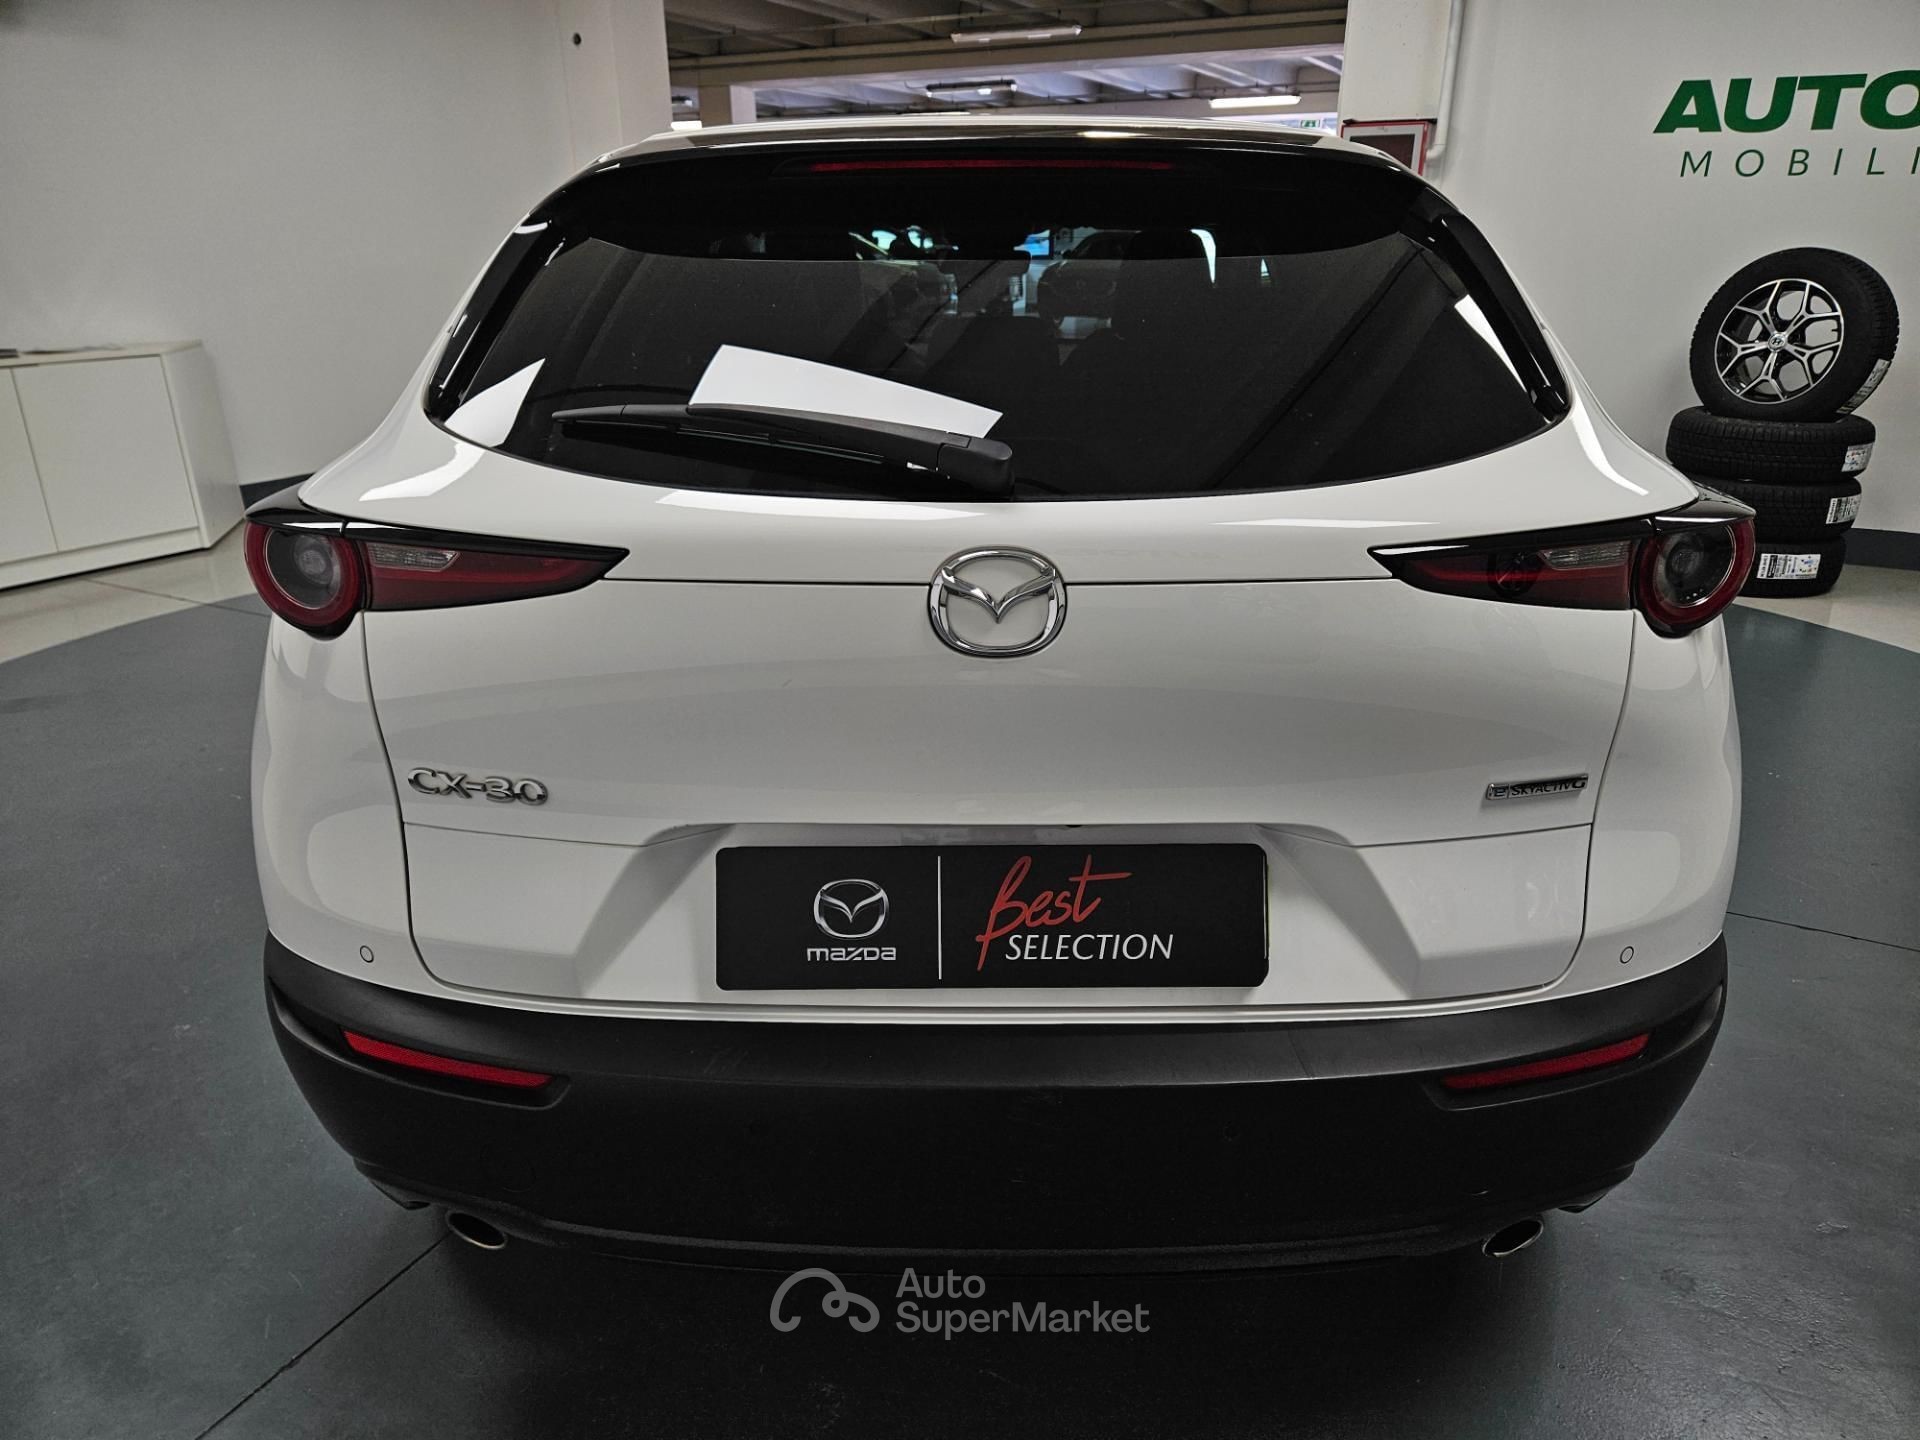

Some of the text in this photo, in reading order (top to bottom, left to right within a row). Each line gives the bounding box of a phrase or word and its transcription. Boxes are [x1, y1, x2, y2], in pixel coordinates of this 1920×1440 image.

[1653, 70, 1920, 133] AUTO
[408, 767, 548, 806] CX-30
[975, 854, 1132, 972] Best
[1005, 933, 1174, 961] SELECTION
